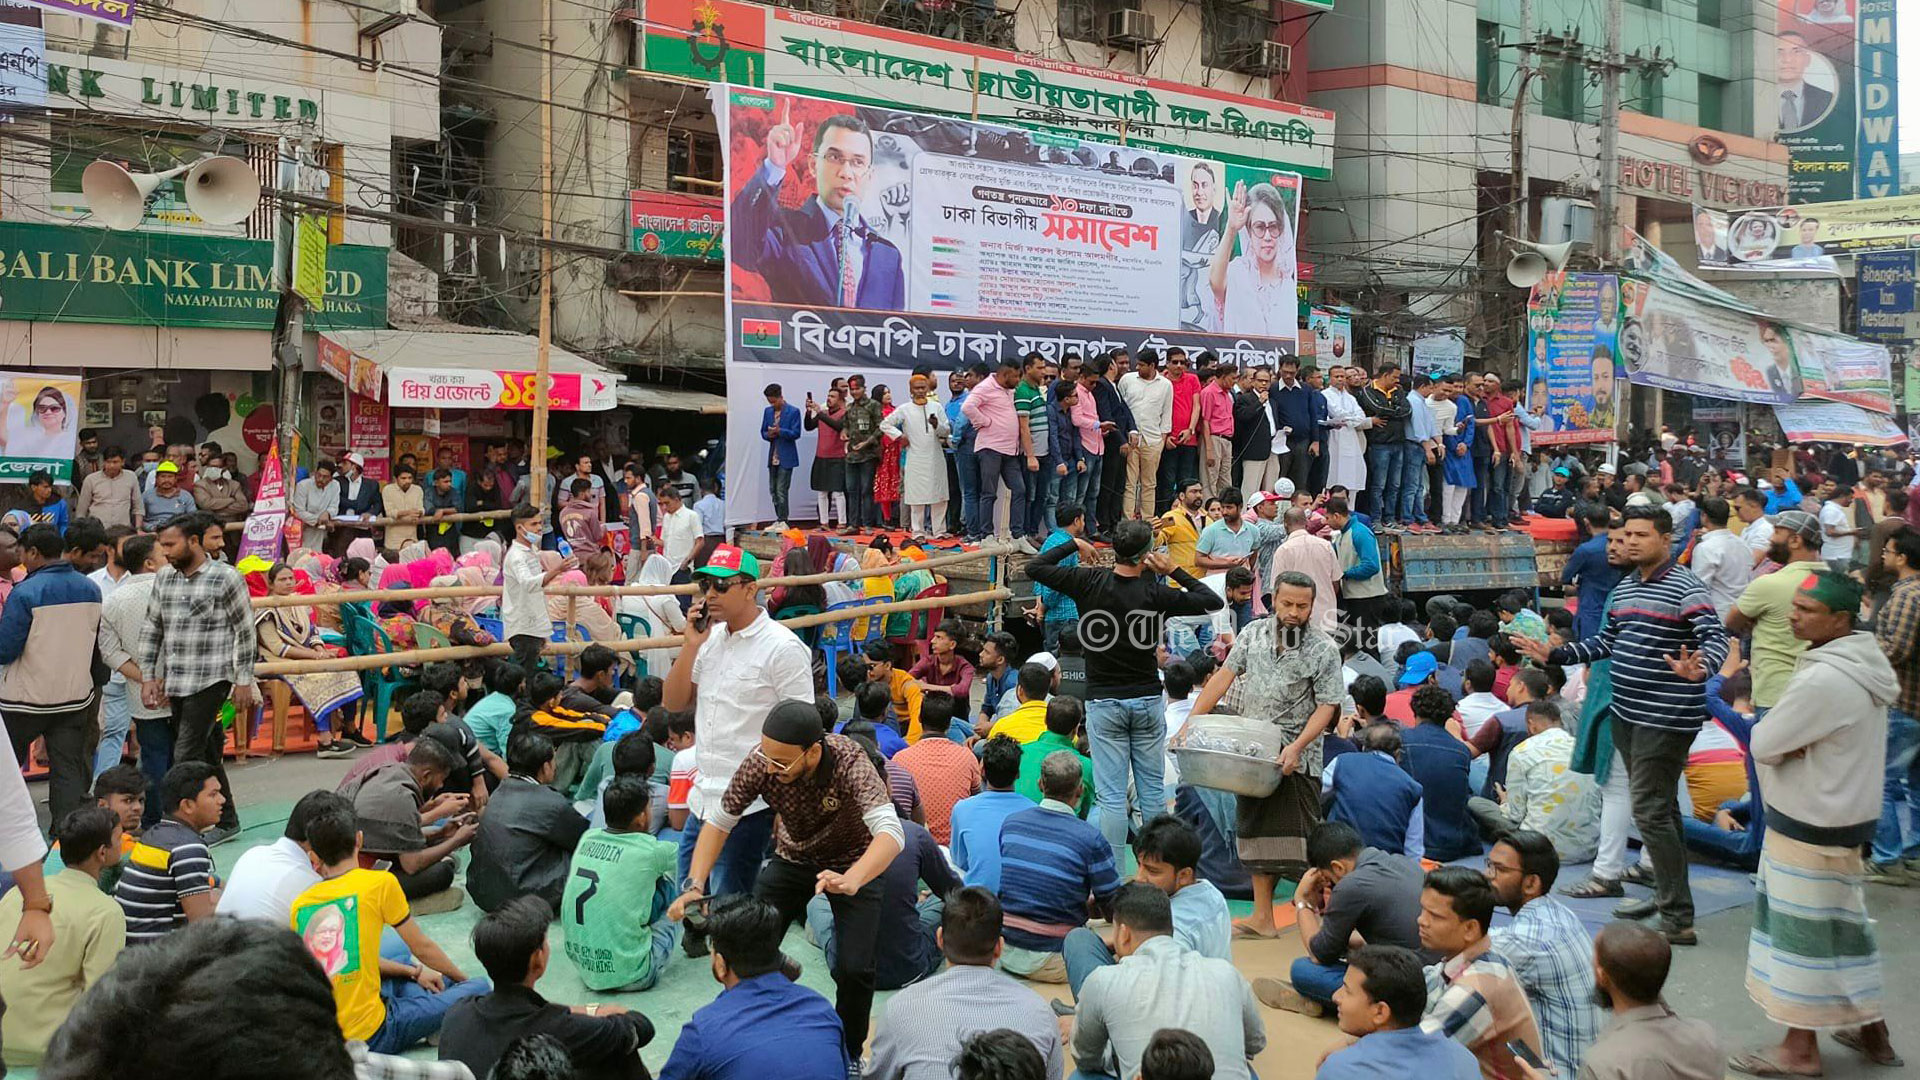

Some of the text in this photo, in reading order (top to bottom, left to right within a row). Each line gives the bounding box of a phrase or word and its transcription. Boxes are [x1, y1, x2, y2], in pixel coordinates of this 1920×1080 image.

[141, 77, 319, 124] LIMITED
[781, 35, 954, 89] বাংলাদেশ
[962, 67, 1161, 126] জাতীয়তাবাদী
[1050, 193, 1078, 213] ১০
[1079, 202, 1096, 213] দফা
[1617, 155, 1788, 208] HOTEL VICTORY
[636, 213, 685, 233] বাংলাদেশ
[942, 203, 1159, 251] ঢাকা বিভাগীয় সমাবেশ
[92, 255, 200, 289] BANK
[210, 263, 362, 297] LIMED
[165, 294, 252, 309] NAYAPALTAN
[788, 313, 1007, 364] বিএনপি-ঢাকা
[401, 380, 491, 402] প্রিয় এজেন্টে
[575, 866, 600, 926] 7
